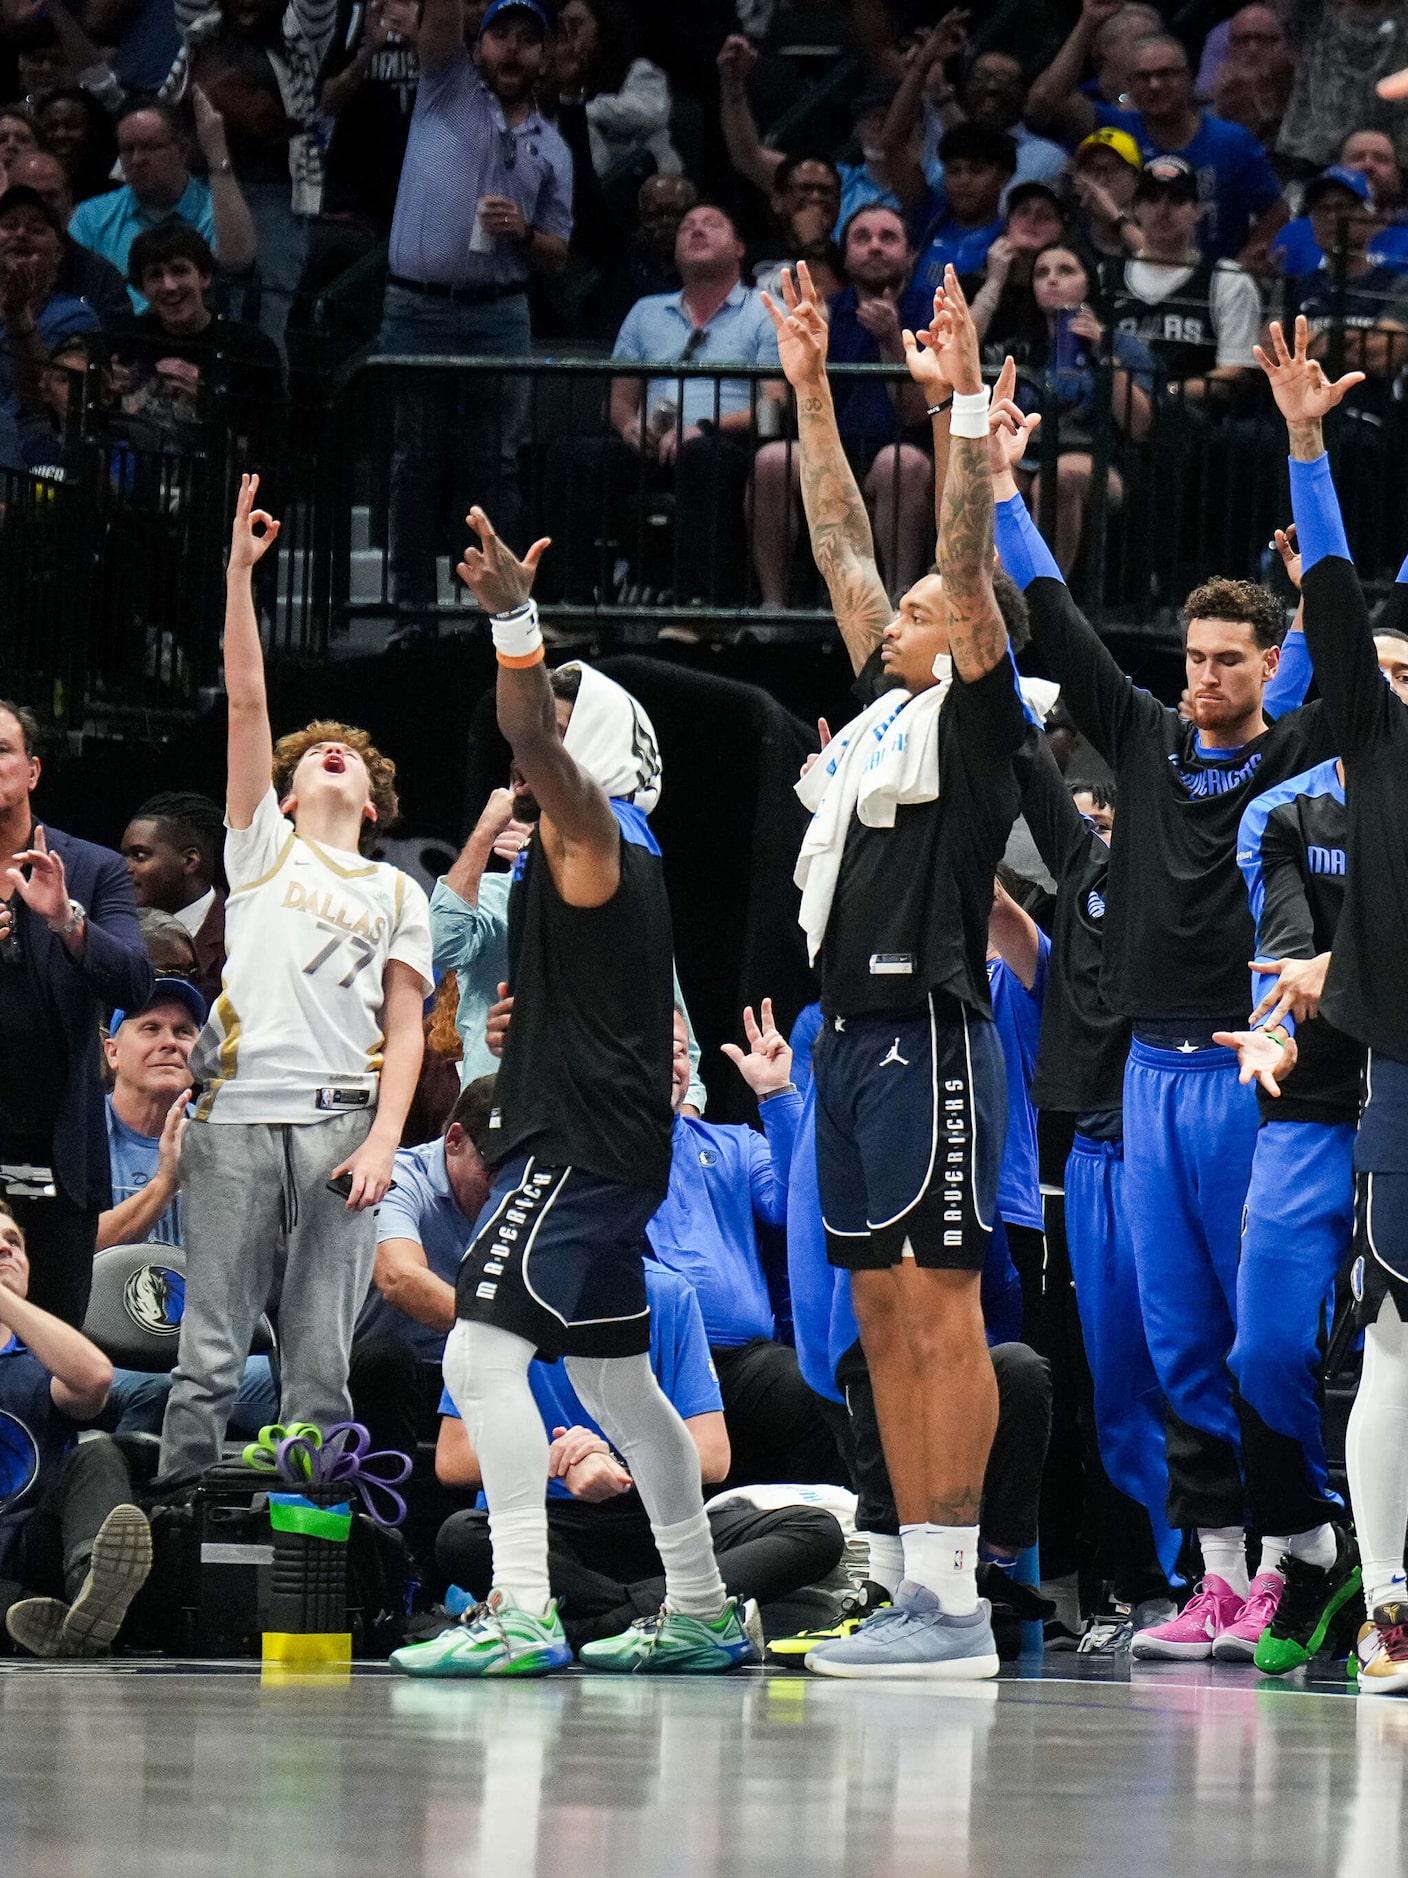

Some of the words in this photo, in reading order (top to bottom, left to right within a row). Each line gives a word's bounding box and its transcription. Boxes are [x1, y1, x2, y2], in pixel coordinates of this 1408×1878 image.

[279, 880, 386, 945] DALLAS
[301, 921, 377, 989] 77
[475, 1163, 556, 1300] MAVERICK
